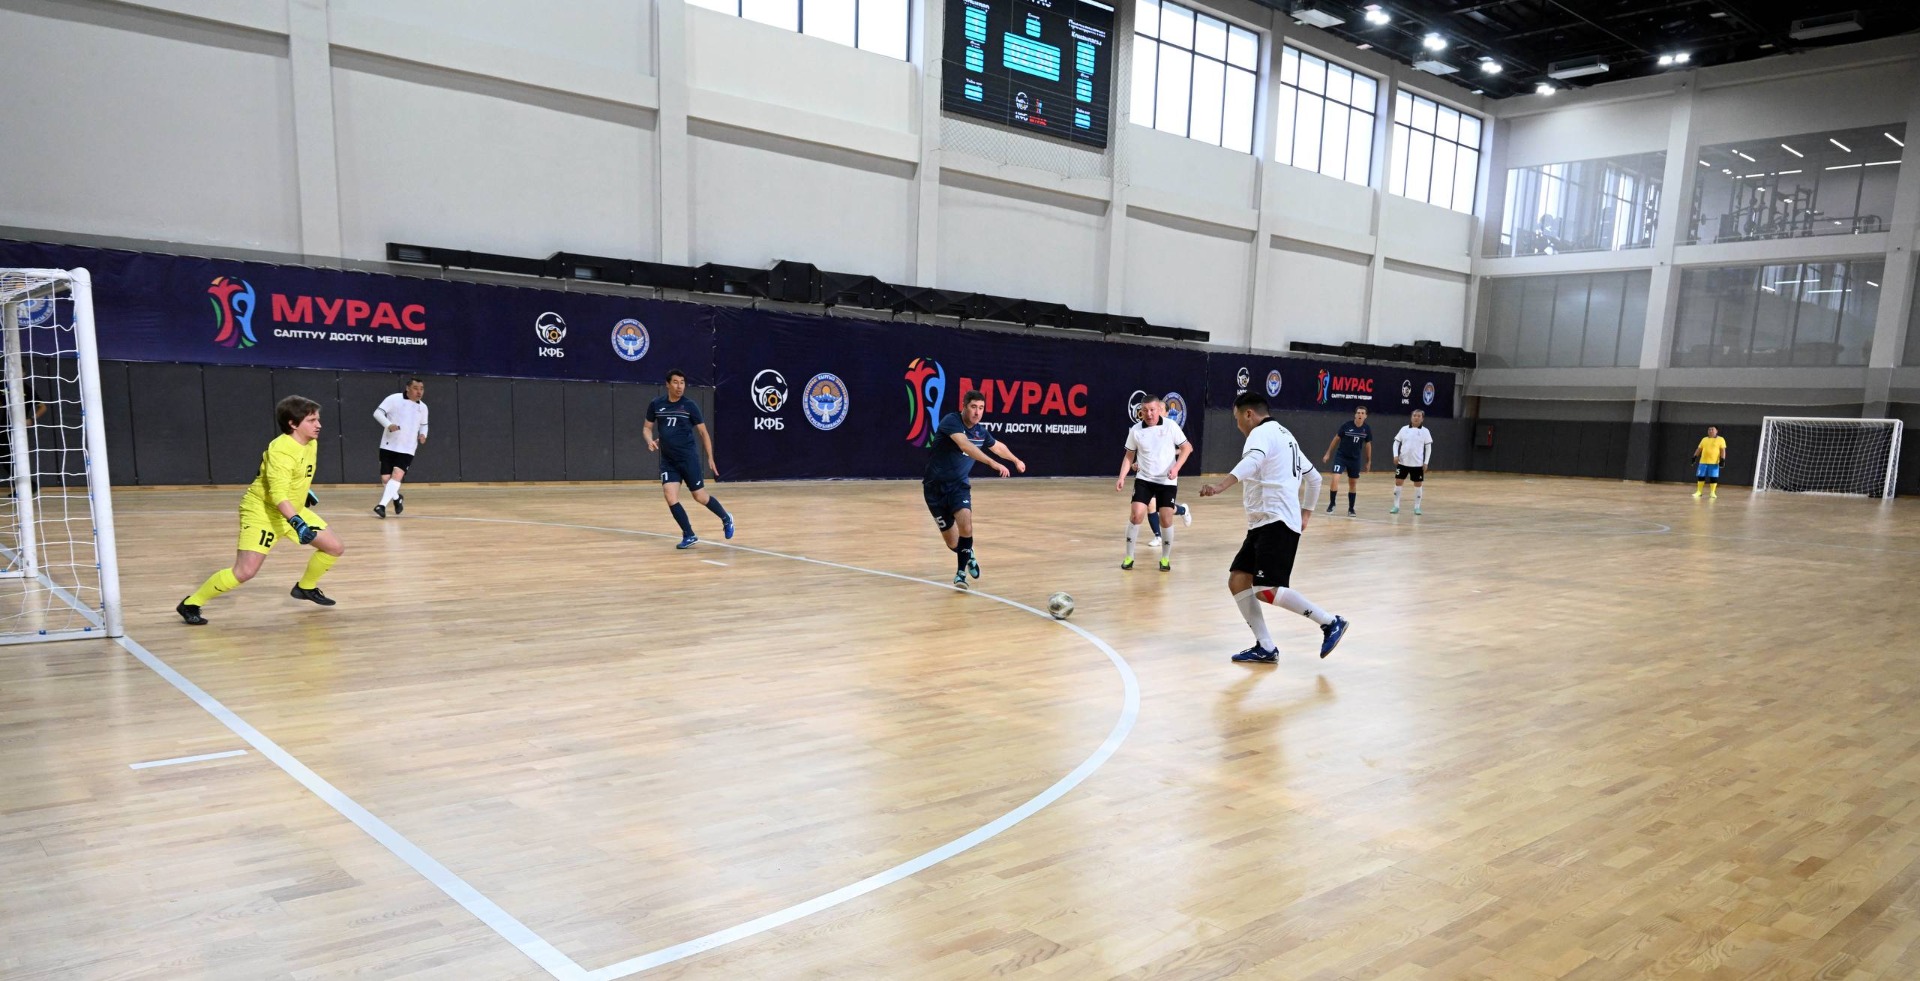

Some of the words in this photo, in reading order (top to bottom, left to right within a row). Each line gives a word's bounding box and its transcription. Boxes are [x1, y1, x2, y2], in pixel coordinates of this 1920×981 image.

[271, 293, 426, 332] МУРАС
[273, 328, 326, 340] САЛТТУУ
[329, 332, 374, 343] ДОСТУК
[377, 336, 428, 346] МЕЛДЕШИ
[538, 346, 565, 358] КФБ
[1332, 376, 1373, 393] МУРАС
[958, 377, 1088, 417] МУРАС
[666, 417, 677, 427] 77
[754, 416, 785, 430] КФБ
[1005, 423, 1042, 433] ДОСТУК
[1045, 424, 1087, 434] МЕЛДЕШИ
[259, 529, 275, 549] 12
